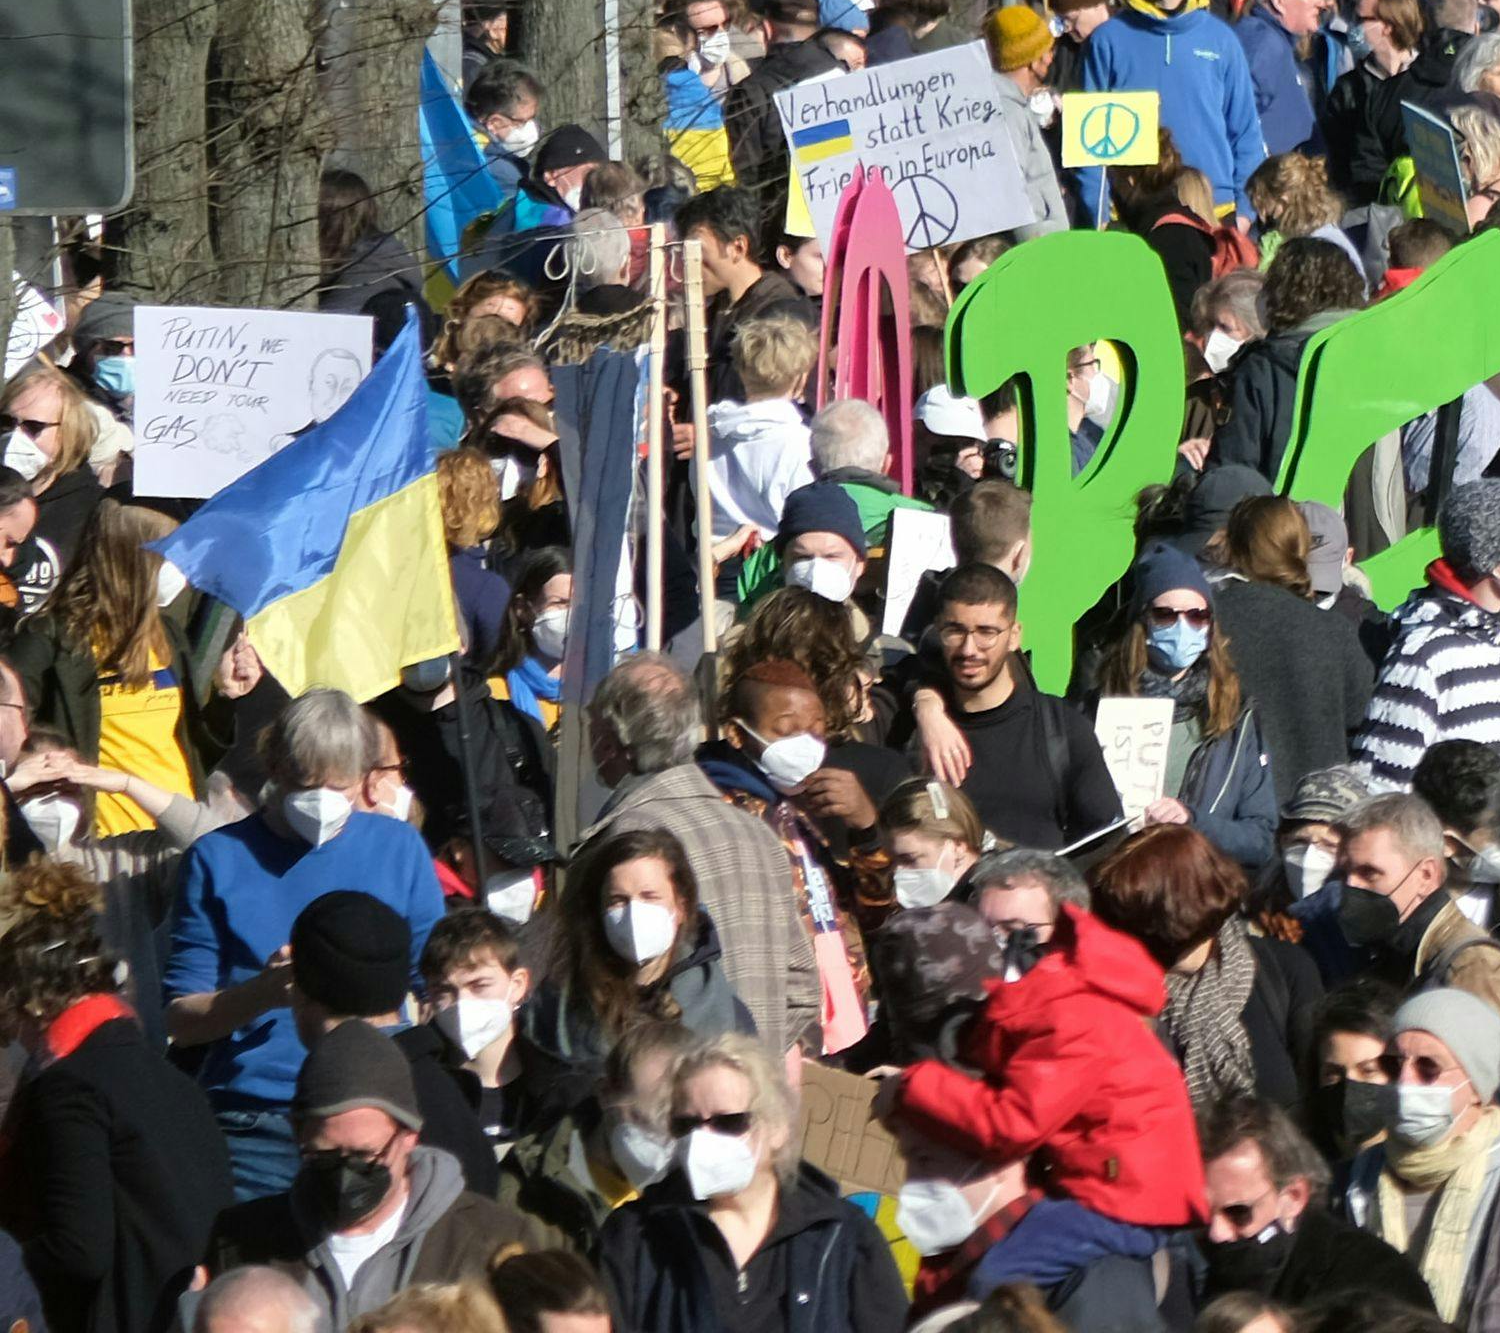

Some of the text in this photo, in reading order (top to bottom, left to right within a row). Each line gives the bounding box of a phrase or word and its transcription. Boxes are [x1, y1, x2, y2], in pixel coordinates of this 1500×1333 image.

[778, 70, 956, 129] Verhandlungen
[865, 107, 926, 149] statt
[897, 151, 919, 182] in
[922, 139, 997, 174] Europa
[161, 316, 290, 358] PUTIN, WE
[171, 353, 274, 389] DON'T
[163, 390, 219, 405] NEED
[143, 415, 200, 449] GAS
[1113, 725, 1134, 771] IST
